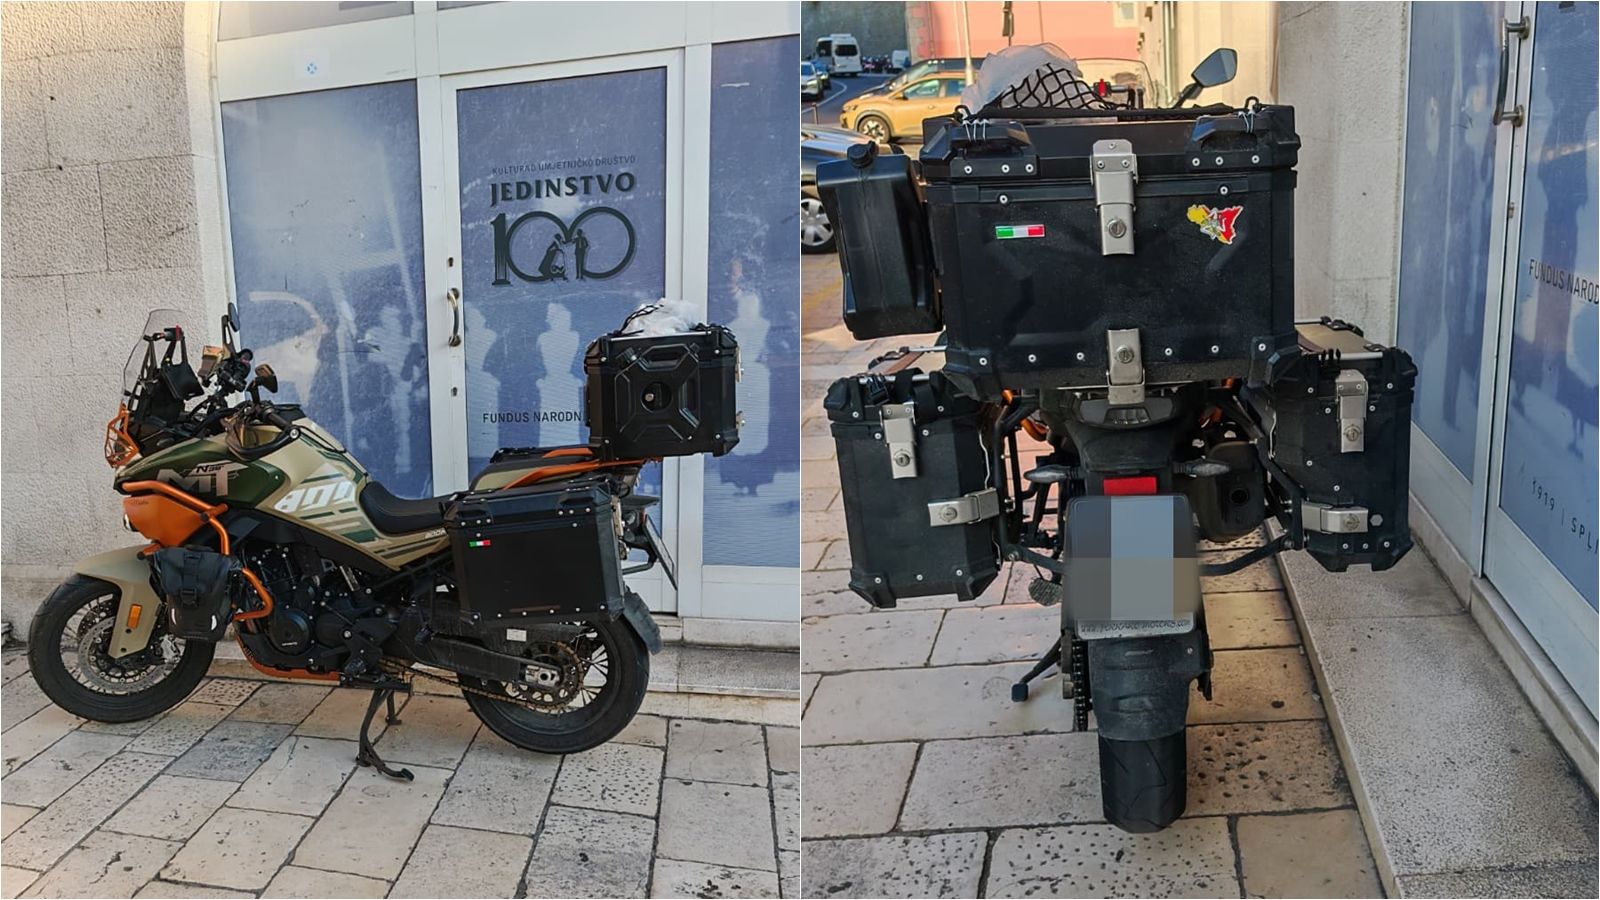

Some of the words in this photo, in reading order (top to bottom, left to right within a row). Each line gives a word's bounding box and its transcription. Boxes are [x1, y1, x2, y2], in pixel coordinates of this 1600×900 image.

[595, 154, 636, 167] DRUŠTVO
[490, 172, 635, 207] JEDINSTVO
[490, 206, 635, 286] 100
[1529, 258, 1565, 289] FUNDUS
[1567, 273, 1599, 304] NAROD
[482, 412, 530, 423] FUNDUS
[533, 411, 581, 422] NARODN
